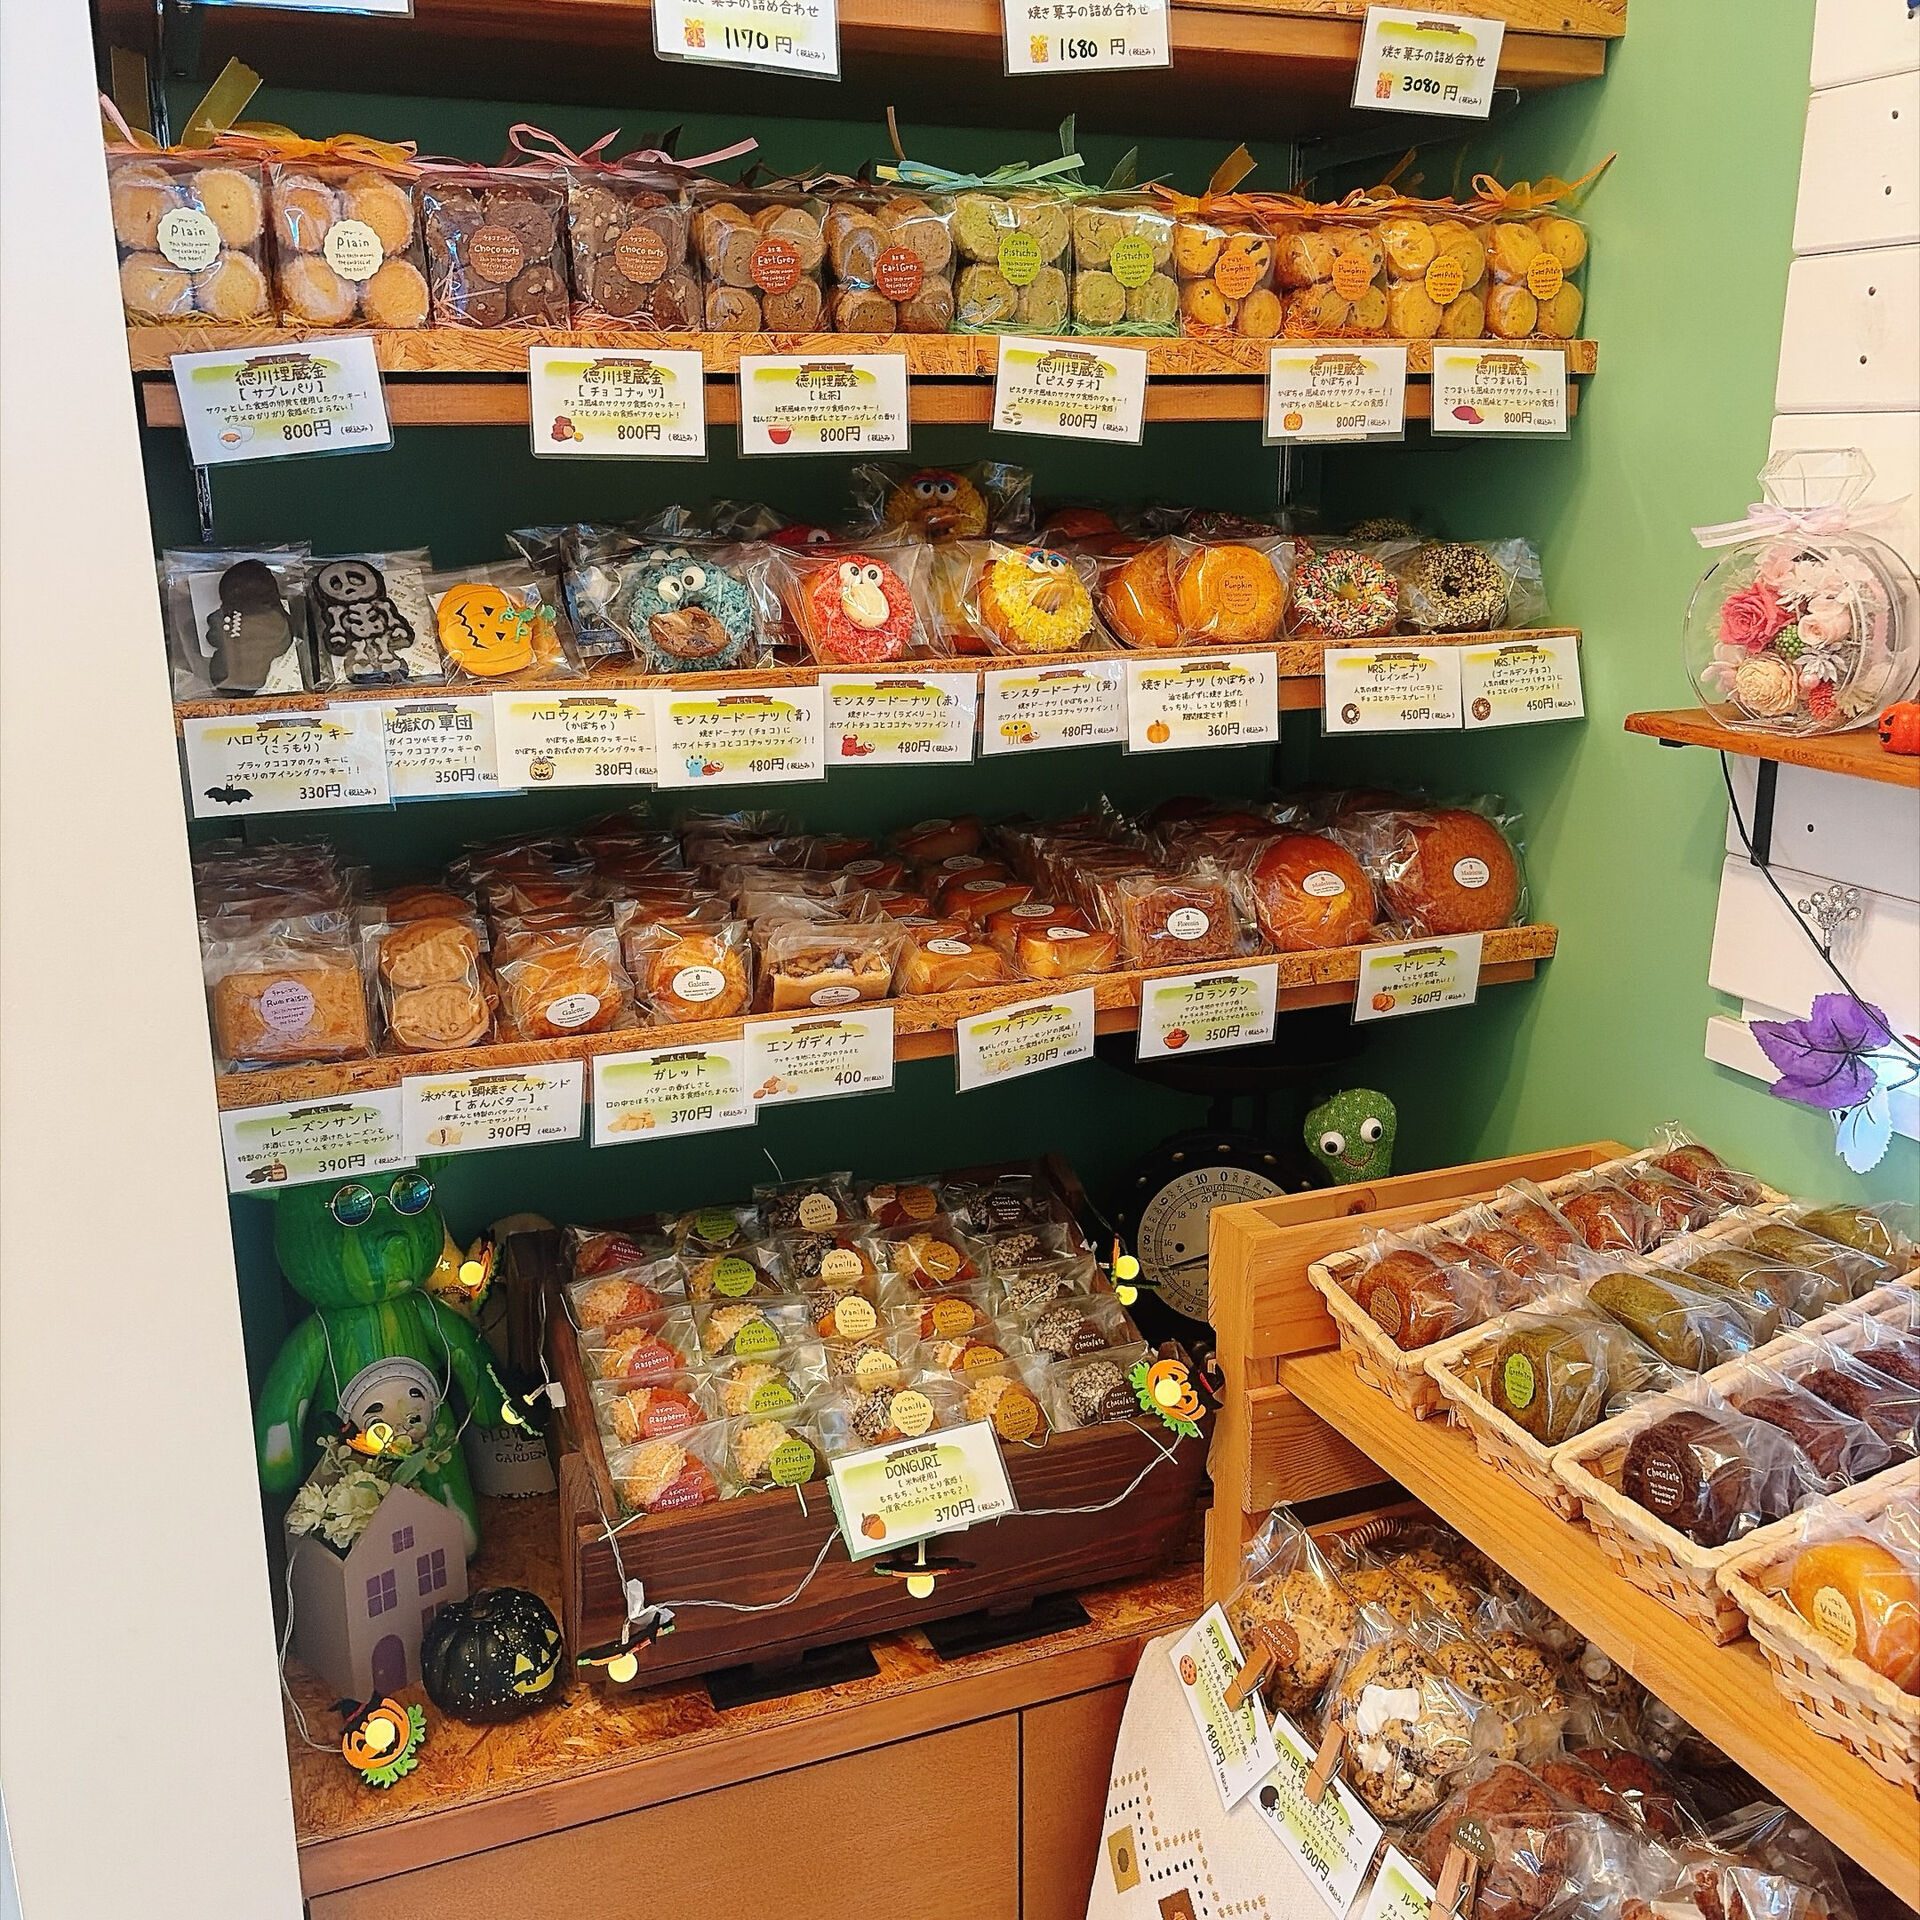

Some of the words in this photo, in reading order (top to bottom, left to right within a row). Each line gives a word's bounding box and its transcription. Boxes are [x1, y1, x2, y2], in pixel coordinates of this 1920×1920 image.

[1028, 3, 1149, 19] 焼き菓子の詰め合わせ
[1382, 46, 1486, 67] 焼き菓子の詰め合わせ
[171, 224, 206, 237] Plain
[337, 236, 369, 249] Plain
[474, 244, 501, 254] Choco
[502, 246, 520, 255] nuts
[620, 245, 646, 254] Choco
[647, 247, 665, 257] nuts
[235, 362, 327, 385] 徳川埋蔵金
[1037, 358, 1107, 379] 徳川埋蔵金
[1309, 363, 1366, 377] 徳川埋蔵金
[1476, 363, 1530, 377] 徳川埋蔵金
[583, 369, 666, 385] 徳川埋蔵金
[796, 375, 860, 388] 徳川埋蔵金
[1036, 374, 1100, 391] 【ピスタチオ】
[578, 387, 665, 399] 【チョコナッツ】
[810, 390, 841, 401] 【紅茶】
[1059, 413, 1097, 429] 800円
[1337, 415, 1366, 428] 800円
[1504, 412, 1532, 424] 800円
[283, 419, 332, 440] 800円
[341, 424, 374, 435] (税込み)
[618, 425, 661, 440] 800円
[668, 433, 698, 441] (税込み)
[821, 426, 861, 442] 800円
[867, 434, 895, 442] (税込み)
[1224, 580, 1252, 590] Pumpkin
[1141, 673, 1264, 691] 焼きドーナツ(かぼちゃ)
[1000, 680, 1117, 700] モンスタードーナツ(黄)
[832, 695, 960, 707] モンスタードーナツ(赤)
[1526, 697, 1554, 711] 450円
[532, 708, 646, 721] ハロウィンクッキー
[673, 709, 812, 725] モンスタードーナツ(青)
[1400, 708, 1430, 720] 450円
[565, 721, 615, 731] (かぼちゃ)
[1062, 723, 1093, 737] 480円
[1208, 722, 1240, 737] 360円
[1242, 726, 1269, 735] (税込み)
[227, 728, 354, 746] ハロウィンクッキー
[264, 743, 320, 755] (こうもり)
[898, 739, 931, 753] 480円
[932, 744, 959, 753] (税込み)
[595, 762, 632, 776] 380円
[749, 758, 785, 772] 480円
[786, 762, 815, 771] (税込み)
[435, 768, 475, 783] 350円
[300, 784, 340, 799] 330円
[344, 787, 377, 797] (税込み)
[1393, 956, 1447, 974] マドレーヌ
[266, 999, 285, 1008] Rum
[286, 995, 309, 1003] raisin
[1185, 986, 1249, 1003] フロランタン
[1410, 990, 1442, 1005] 360円
[992, 1013, 1063, 1035] フィナンシェ
[1206, 1024, 1241, 1041] 350円
[767, 1032, 865, 1053] エンガディナー
[1024, 1047, 1058, 1066] 330円
[653, 1065, 706, 1080] ガレット
[834, 1070, 861, 1086] 400
[454, 1093, 535, 1111] 【あんバター】
[670, 1106, 712, 1123] 370円
[270, 1111, 378, 1138] レーズンサンド
[488, 1123, 532, 1139] 390円
[318, 1154, 365, 1173] 390円
[804, 1203, 831, 1215] Vanilla
[827, 1260, 856, 1270] Vanilla
[841, 1308, 870, 1317] Vanilla
[634, 1355, 669, 1370] Raspberry
[896, 1401, 926, 1414] Vanilla
[1106, 1396, 1135, 1409] Chocolate
[648, 1412, 687, 1423] Raspberry
[1003, 1408, 1030, 1420] Almond
[495, 1449, 547, 1463] GARDEN
[776, 1454, 811, 1465] Pistachio
[884, 1454, 942, 1479] DONGURI
[1646, 1467, 1680, 1483] Chocolate
[661, 1492, 699, 1507] Raspberry
[934, 1498, 975, 1522] 370円
[1820, 1602, 1851, 1628] Vanilla
[1262, 1626, 1281, 1646] Choco
[1280, 1643, 1294, 1658] nuts
[1205, 1723, 1226, 1766] 480円
[1458, 1828, 1485, 1851] Kokuto
[1300, 1840, 1330, 1881] 500円
